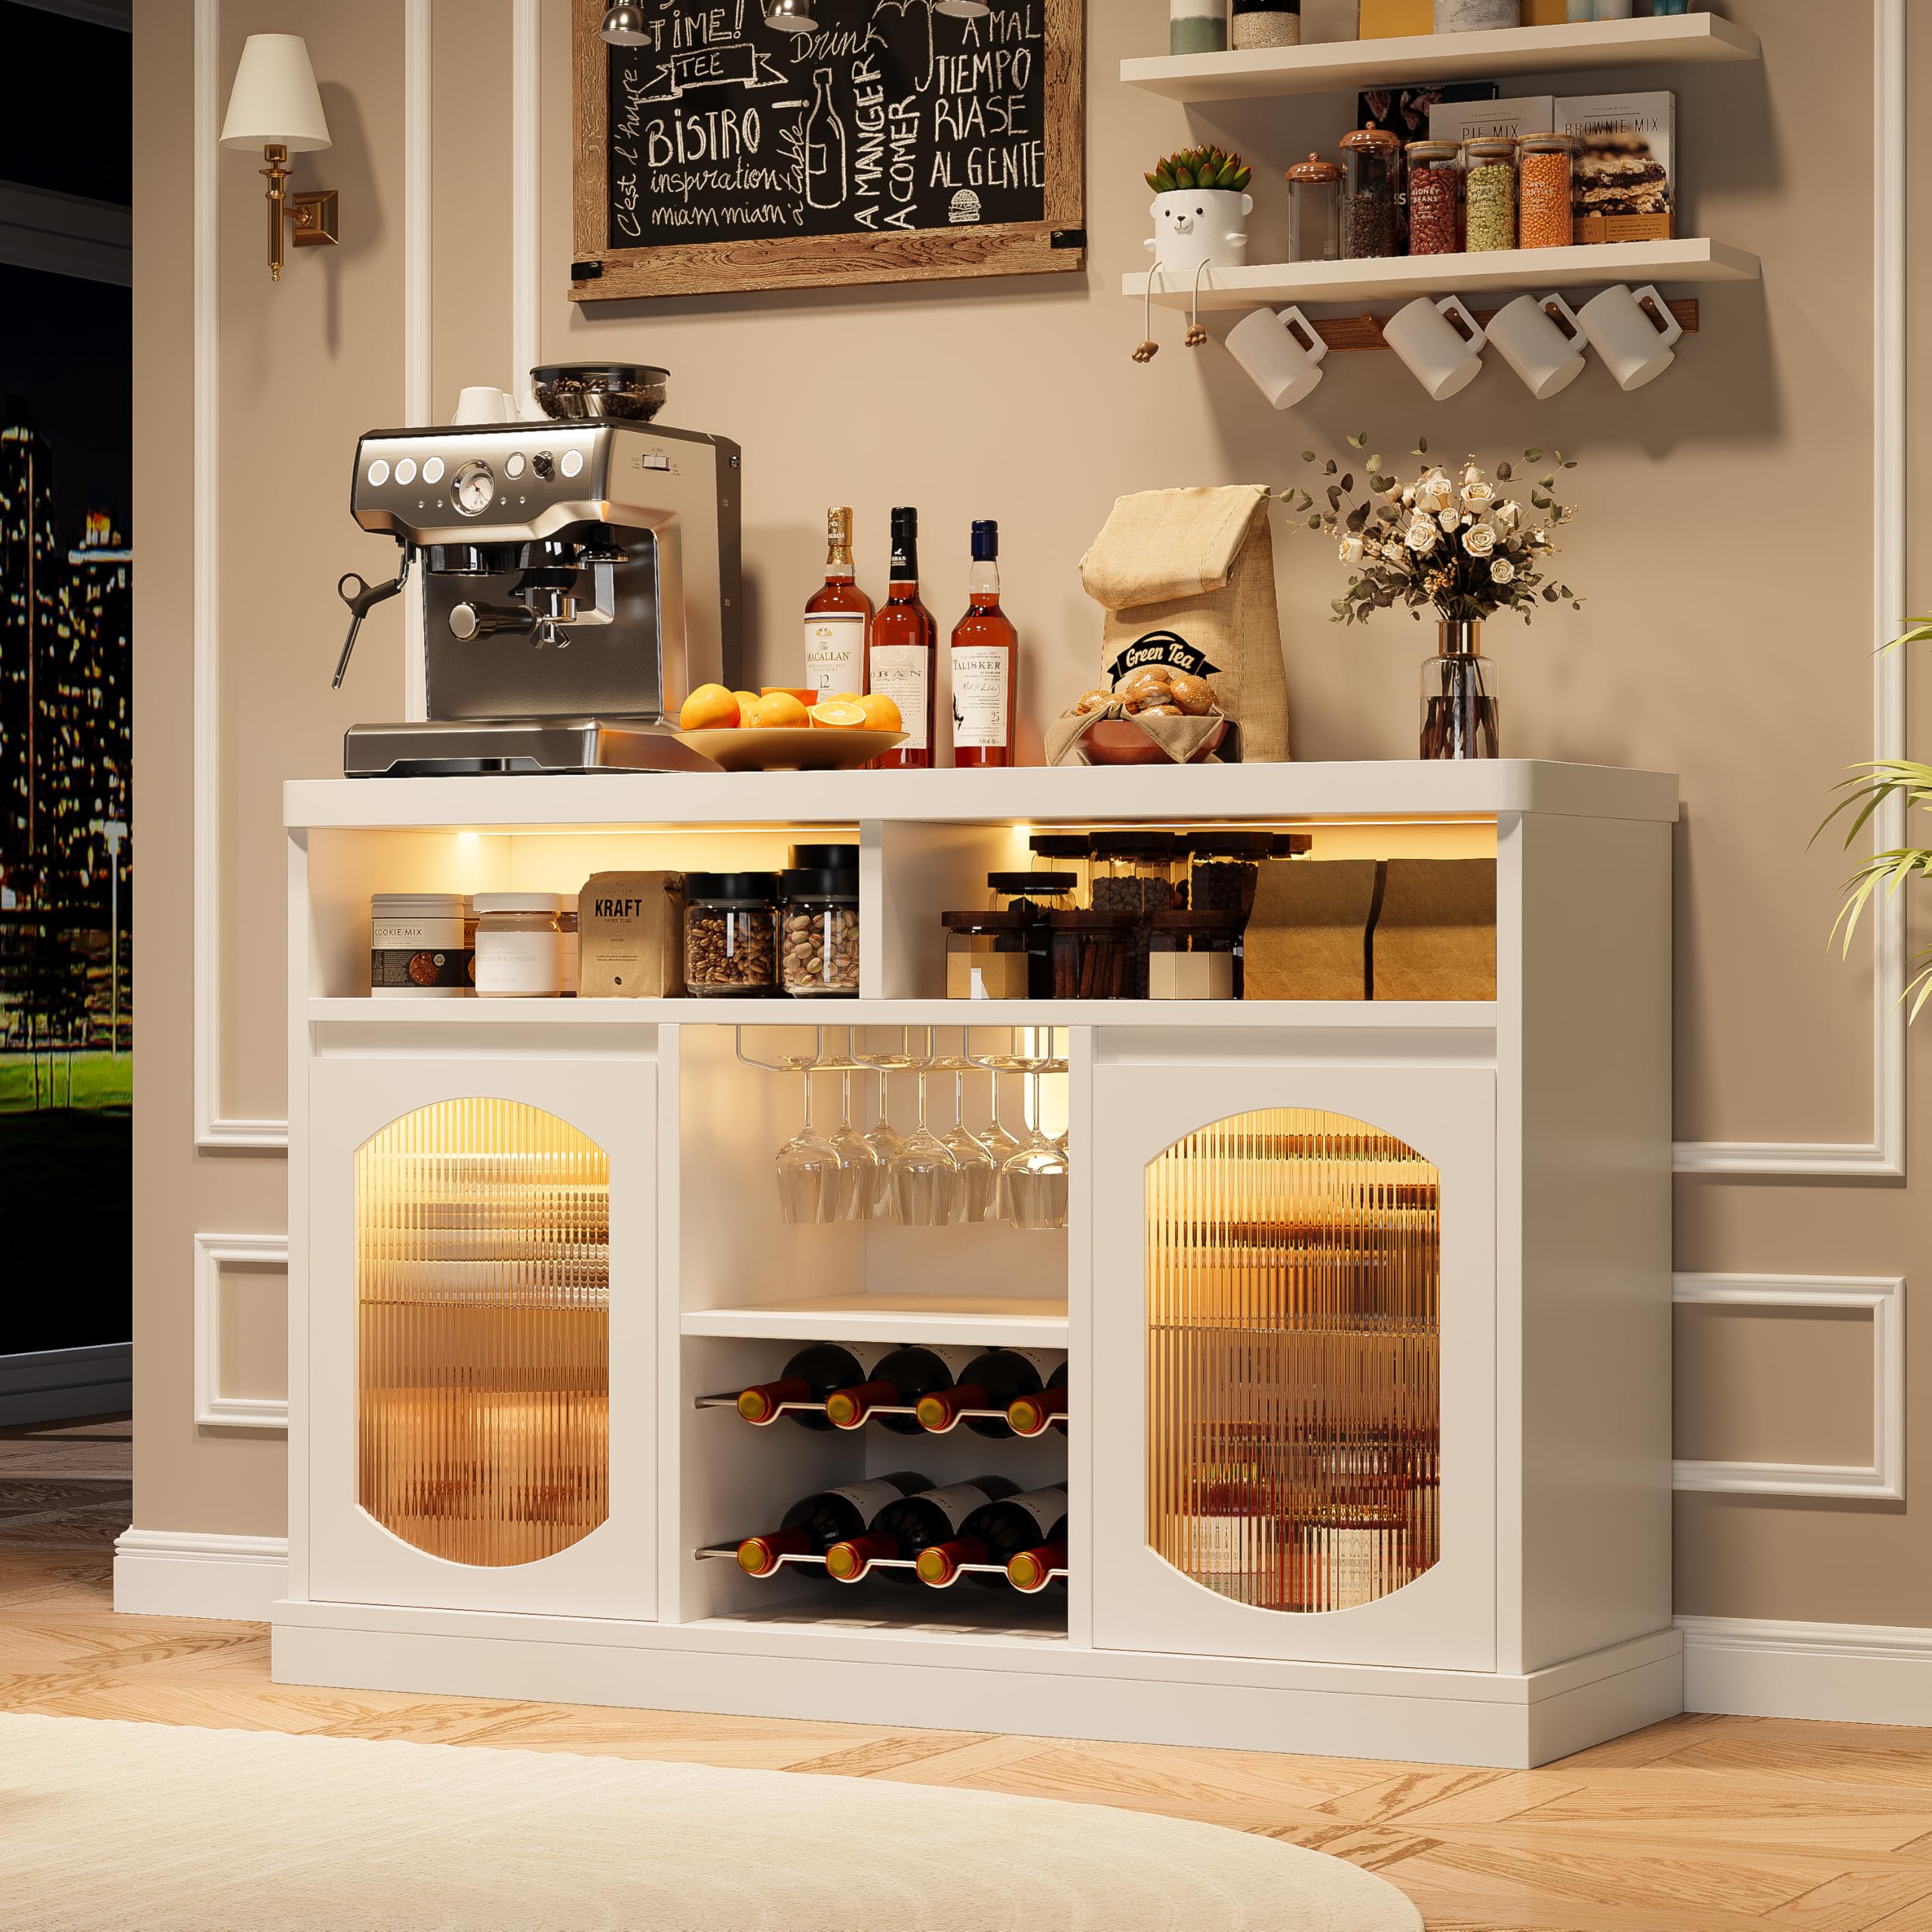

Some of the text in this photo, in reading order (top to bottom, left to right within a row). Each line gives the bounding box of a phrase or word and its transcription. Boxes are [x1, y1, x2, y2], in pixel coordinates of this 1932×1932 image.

[962, 4, 1041, 48] A MAL
[790, 21, 888, 63] Drink
[677, 53, 724, 78] TEE
[935, 48, 1031, 95] TIEMPO
[934, 94, 1029, 142] RIASE
[1564, 117, 1660, 137] BROWNIE MIX
[851, 53, 887, 229] A MANGER
[1463, 124, 1518, 140] PIE MIX
[884, 94, 921, 229] A COMER
[930, 140, 1044, 189] AL GENTE
[651, 155, 782, 203] inspiration
[651, 202, 786, 226] miam miam
[807, 651, 850, 663] MACALLAN
[817, 641, 829, 651] The
[1126, 643, 1195, 669] Green Tea
[870, 670, 921, 678] OBAN
[953, 659, 1001, 671] TALISKER
[820, 674, 829, 688] 12
[991, 711, 1000, 722] 25
[595, 899, 642, 917] KRAFT
